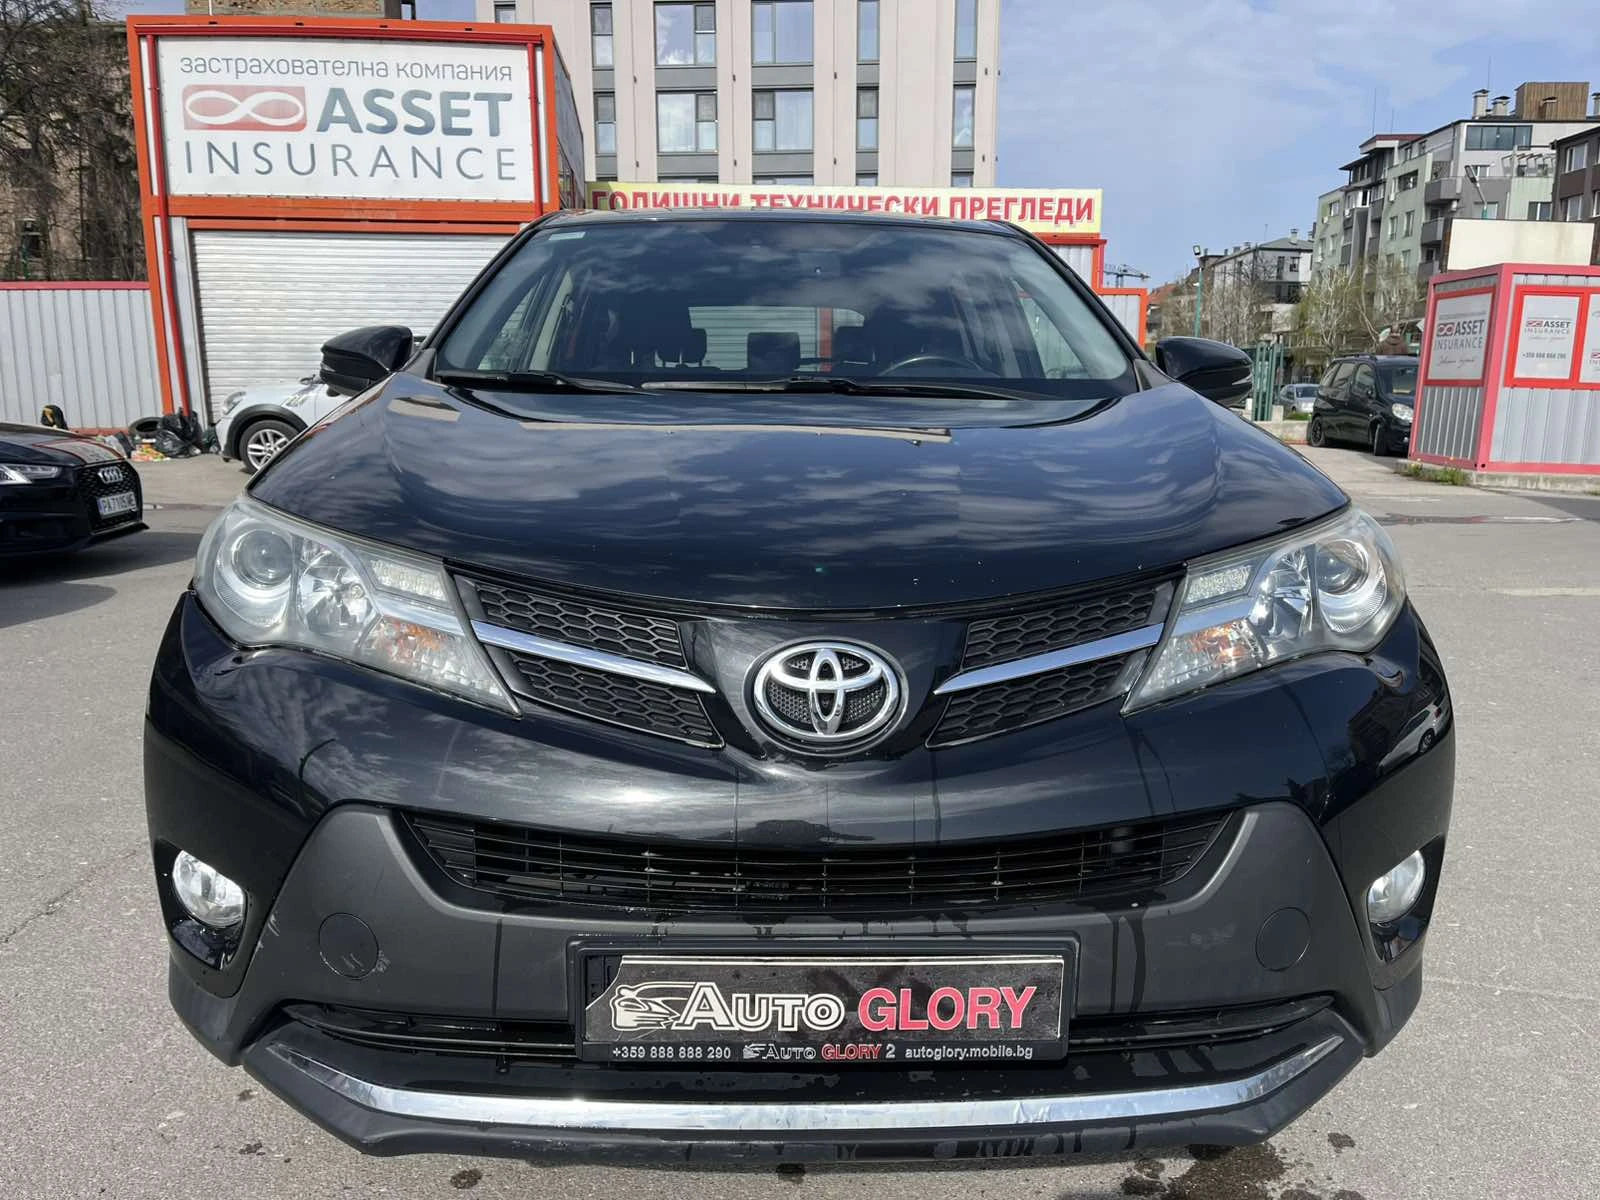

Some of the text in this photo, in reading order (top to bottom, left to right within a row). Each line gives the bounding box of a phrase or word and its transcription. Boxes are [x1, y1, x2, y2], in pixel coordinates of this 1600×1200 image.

[179, 55, 513, 82] застрахователна компания
[316, 87, 513, 137] ASSET
[184, 140, 517, 181] INSURANCE
[948, 197, 1094, 226] ПРЕГЛЕДИ
[1454, 320, 1485, 336] ASSET
[1543, 321, 1572, 329] ASSET
[1434, 337, 1483, 351] INSURANCE
[856, 985, 1038, 1032] GLORY
[612, 1046, 646, 1059] +359
[650, 1046, 674, 1059] 888
[678, 1046, 703, 1059] 888
[706, 1046, 731, 1059] 290
[821, 1043, 882, 1060] GLORY
[885, 1044, 896, 1059] 2
[905, 1044, 1033, 1060] autoglory.mobile.bg
